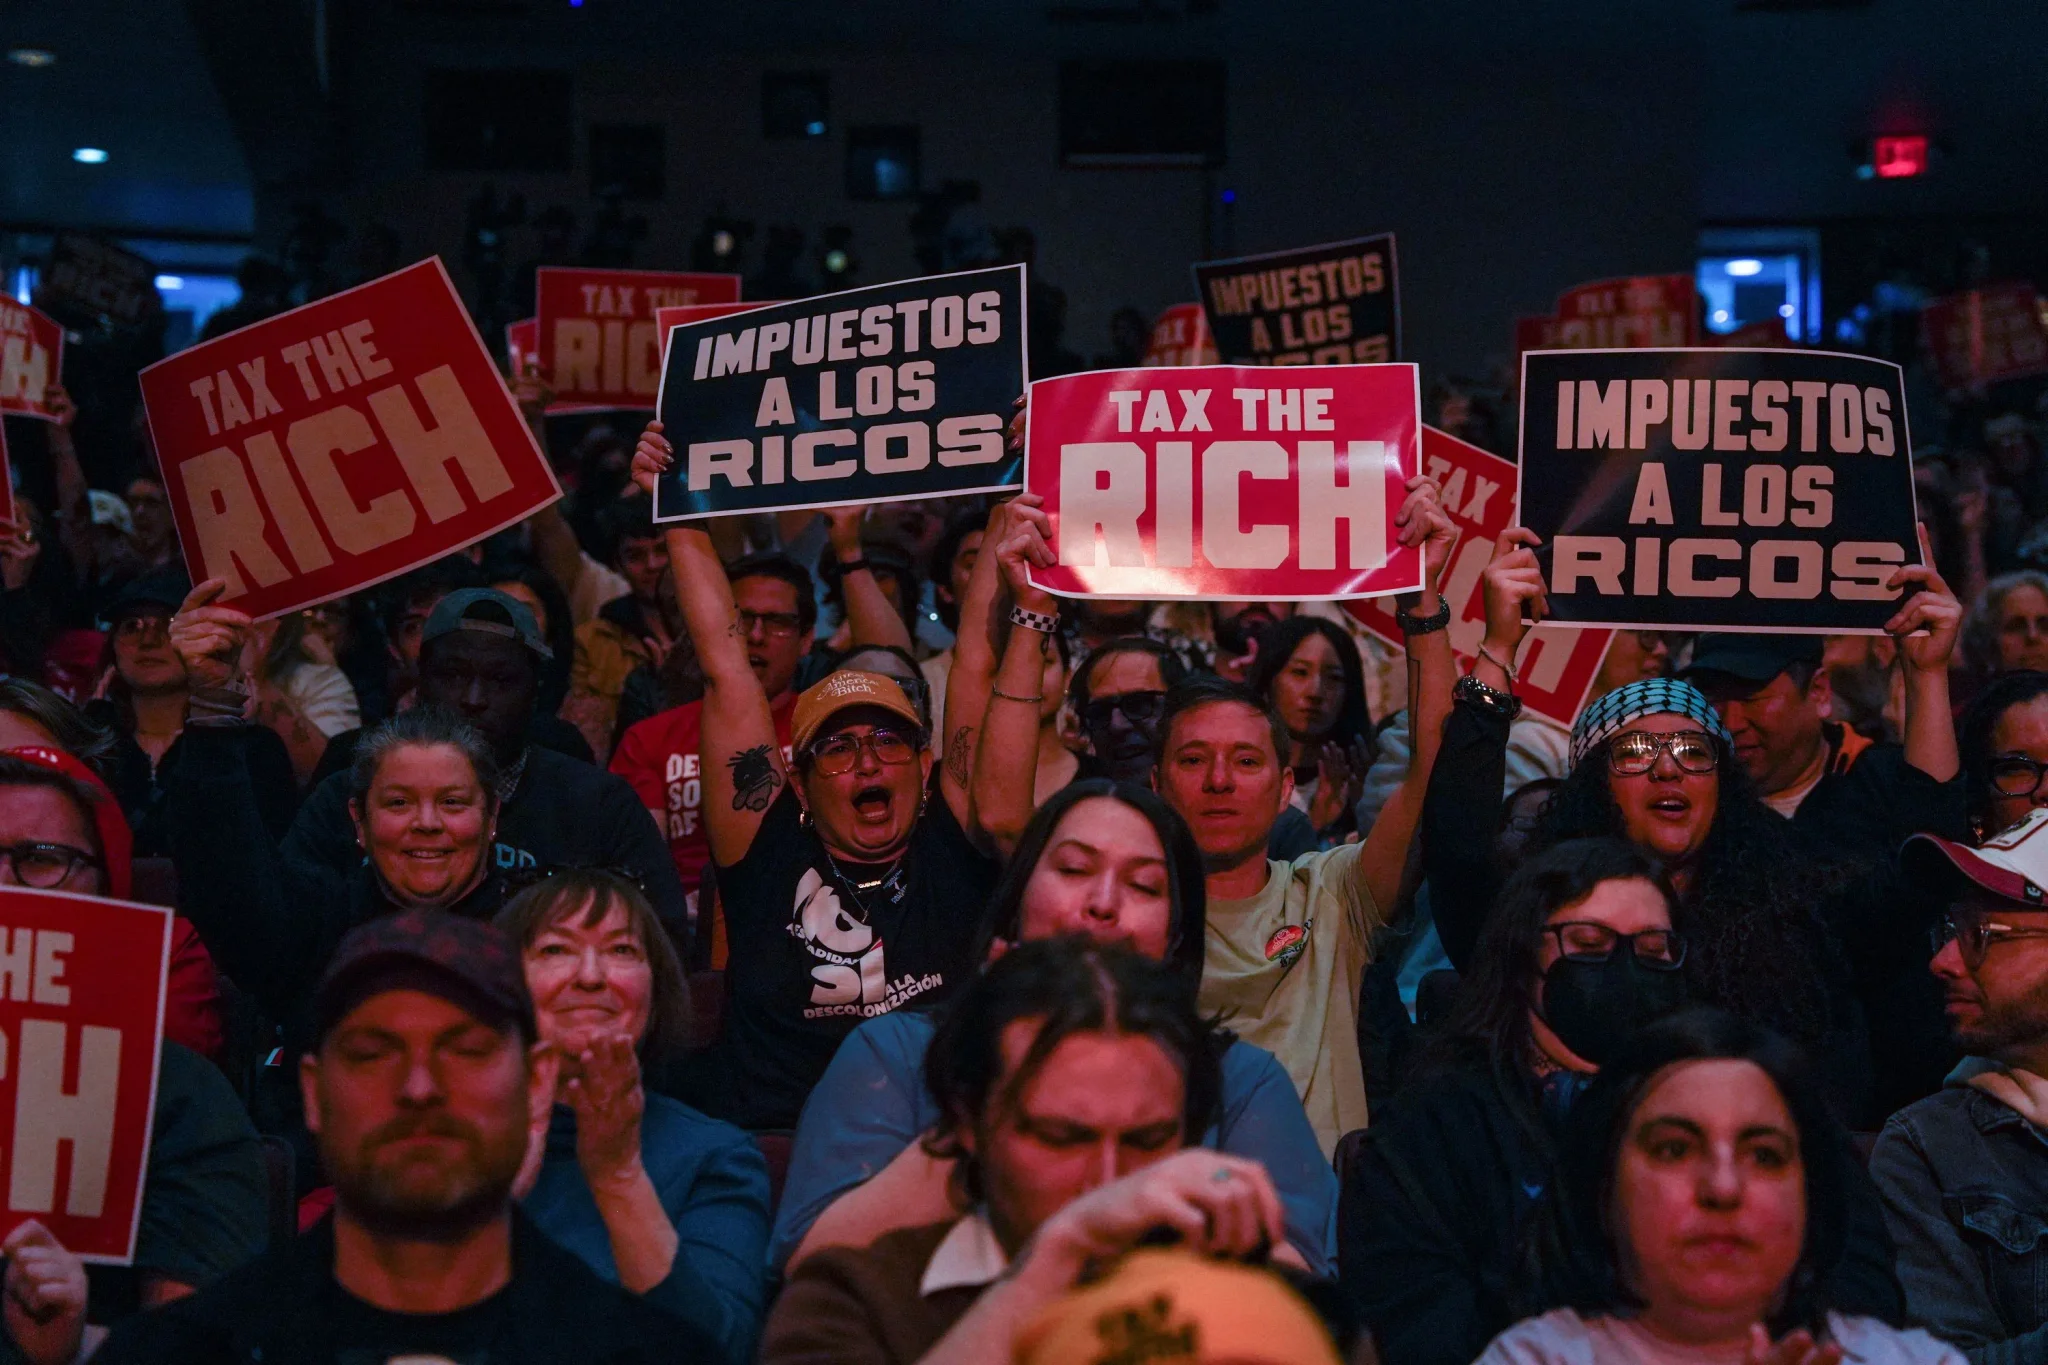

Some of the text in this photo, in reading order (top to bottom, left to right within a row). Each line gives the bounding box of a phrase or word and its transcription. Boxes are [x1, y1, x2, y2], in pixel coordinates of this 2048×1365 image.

[580, 283, 637, 317] TAX
[1208, 251, 1386, 317] IMPUESTOS
[552, 316, 660, 396] RIC
[693, 290, 1001, 381] IMPUESTOS
[1251, 316, 1272, 352] A
[1279, 303, 1353, 350] LOS
[190, 319, 394, 437] TAX THE
[755, 360, 936, 428] A LOS
[1109, 387, 1335, 433] TAX THE
[688, 413, 1004, 492] RICOS
[1556, 379, 1896, 457] IMPUESTOS
[180, 363, 515, 602] RICH
[1058, 440, 1388, 570] RICH
[1426, 454, 1501, 526] TAX
[1628, 462, 1835, 529] A LOS
[1551, 535, 1906, 601] RICOS
[0, 923, 76, 1008] HE
[803, 972, 943, 1020] DESCOLONIZACIÓN
[893, 973, 916, 992] LA
